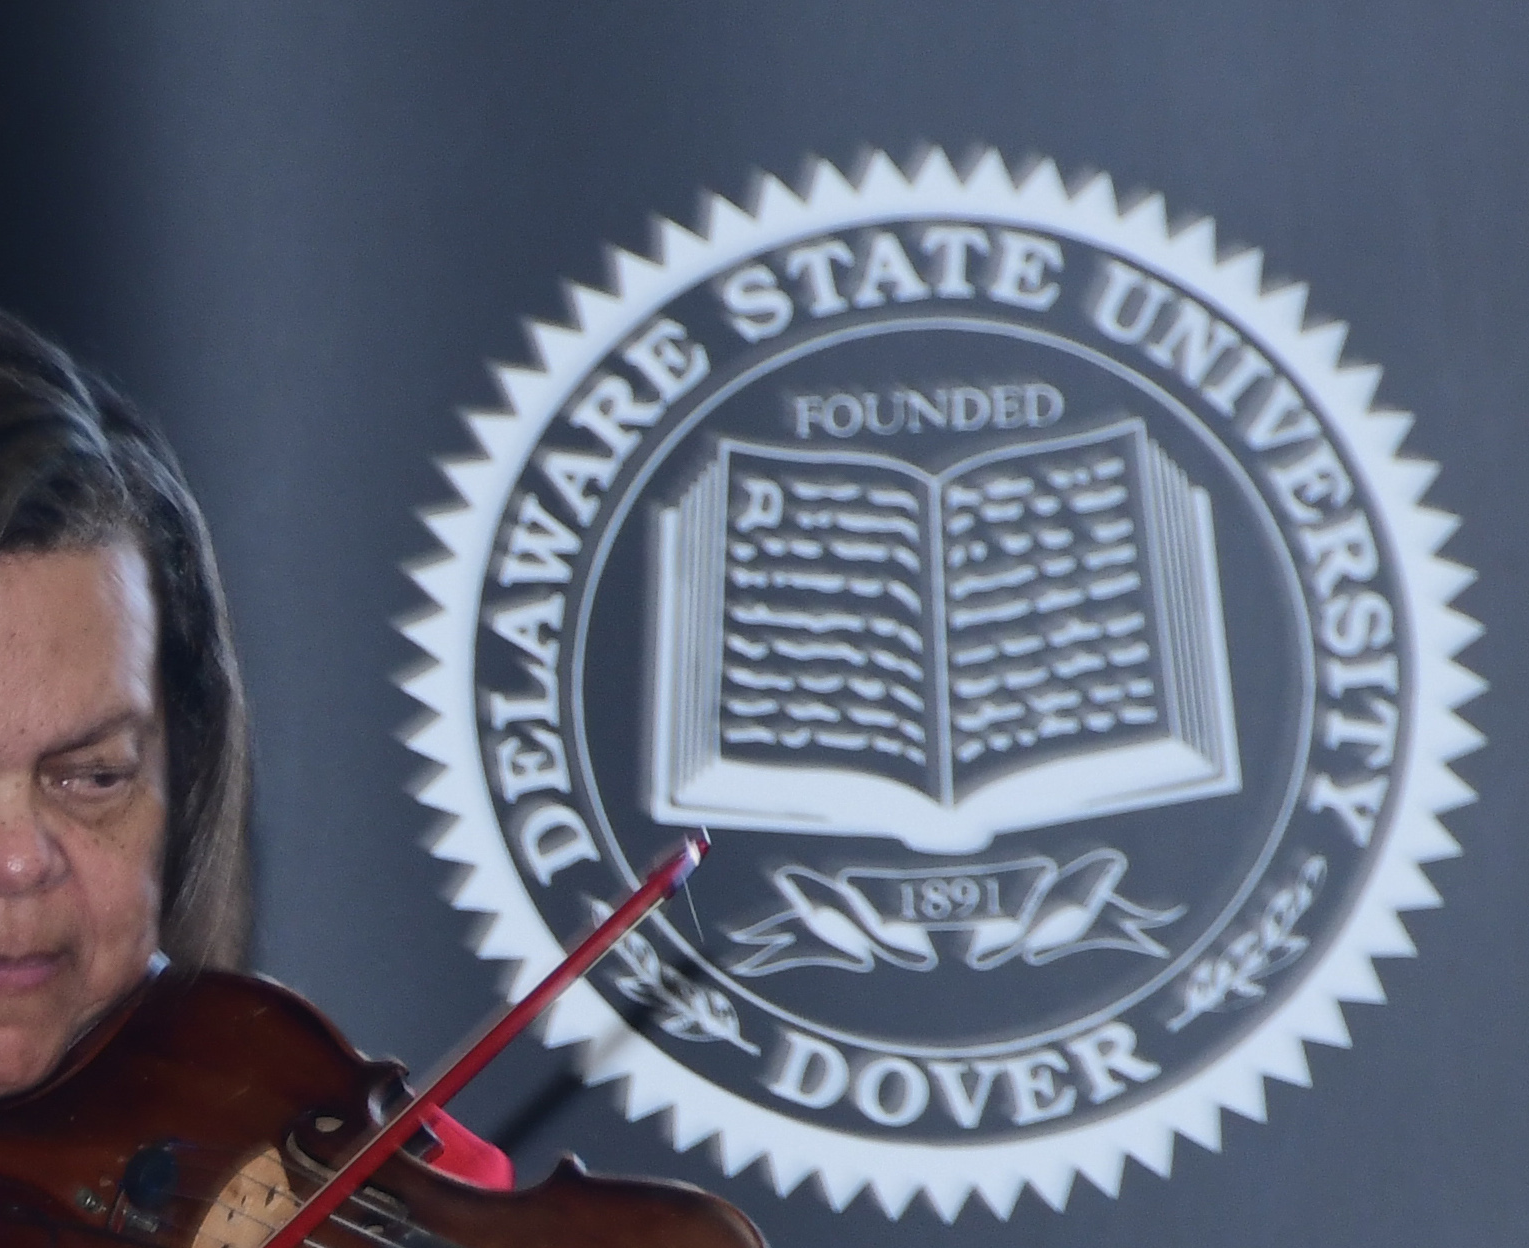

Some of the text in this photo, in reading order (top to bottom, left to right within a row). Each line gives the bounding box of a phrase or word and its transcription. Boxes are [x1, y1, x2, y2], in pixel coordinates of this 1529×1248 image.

[795, 383, 1065, 439] FOUNDED
[490, 226, 1399, 883] DELAWARE STATE UNIVERSITY
[900, 877, 1002, 920] 1891
[769, 1023, 1159, 1128] DOVER
